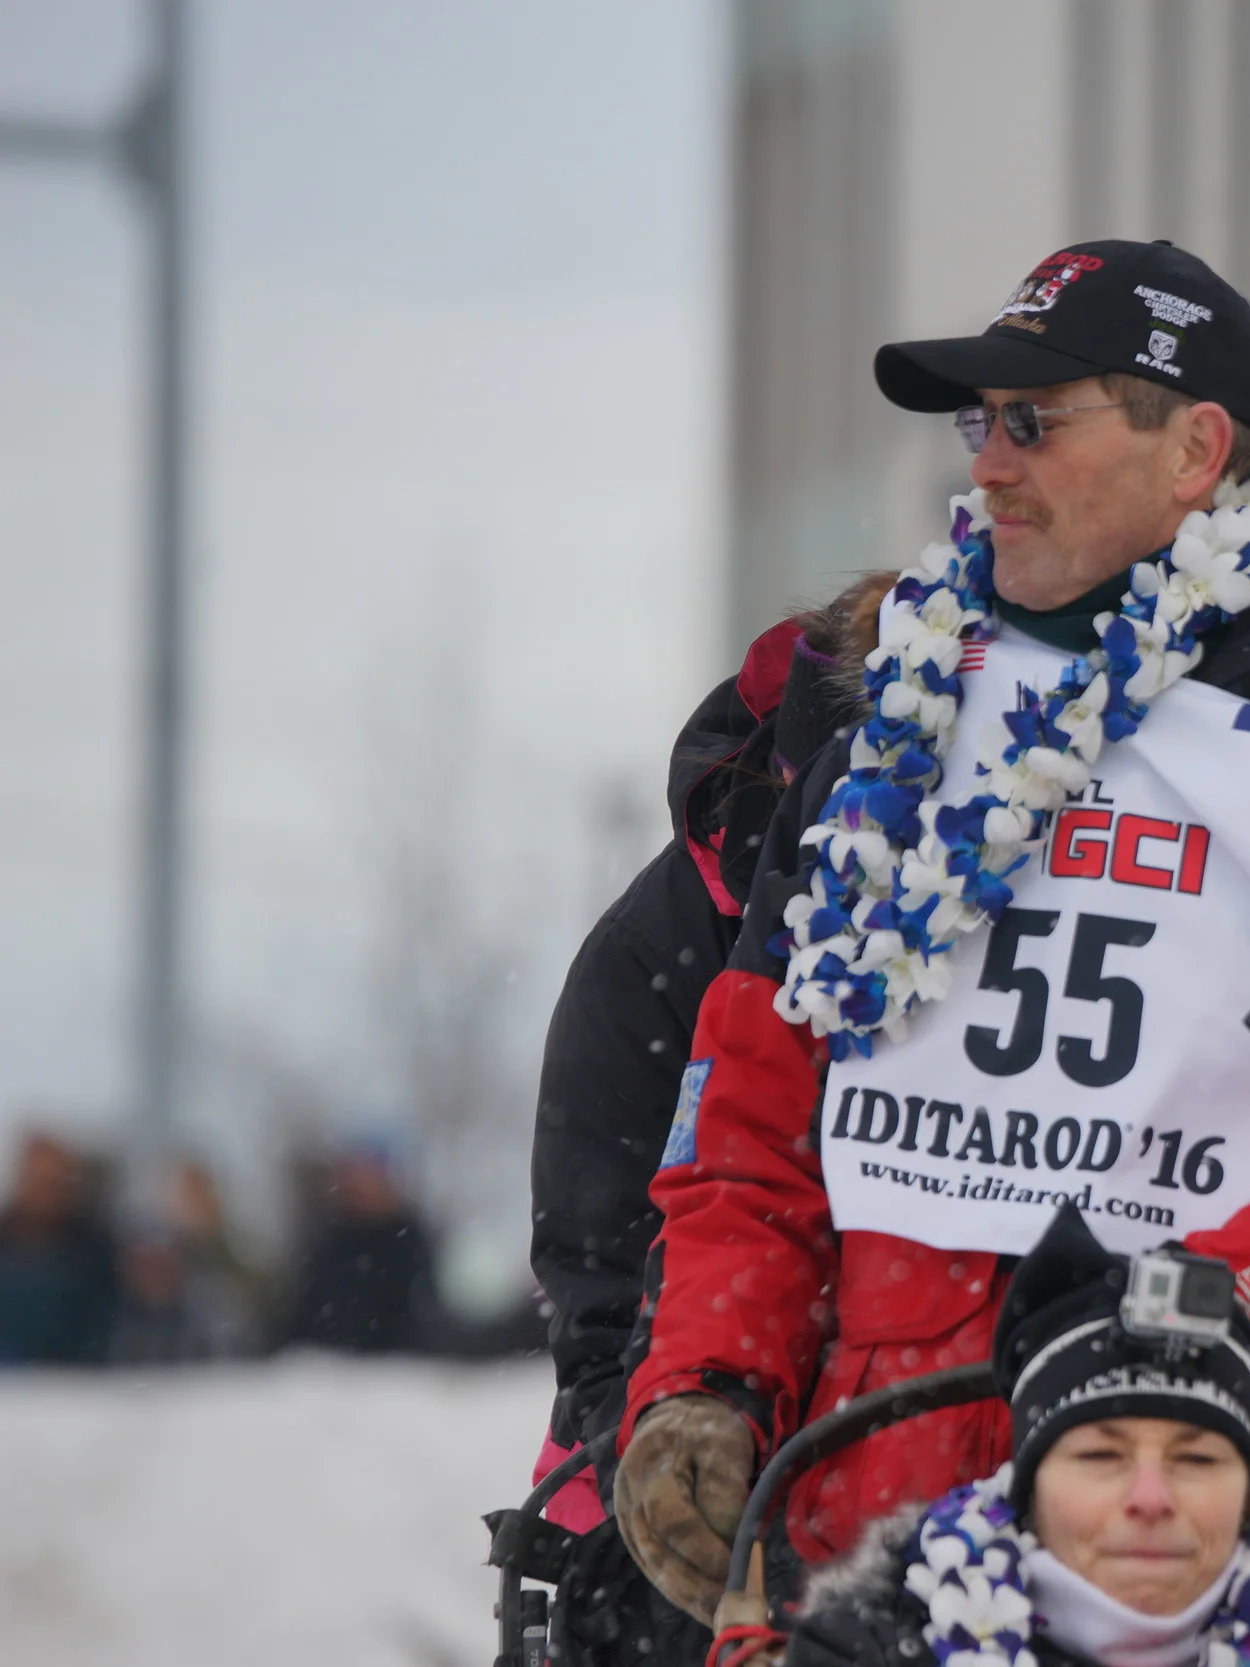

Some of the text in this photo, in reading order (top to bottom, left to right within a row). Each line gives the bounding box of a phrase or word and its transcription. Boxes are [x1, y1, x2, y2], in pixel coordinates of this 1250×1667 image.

[1133, 284, 1213, 322] ANCHORAGE
[1144, 299, 1199, 324] CHRYSLER
[1151, 309, 1188, 328] DODGE
[1134, 352, 1183, 377] RAM
[1050, 807, 1211, 895] GCI
[963, 907, 1157, 1087] 55
[830, 1086, 1226, 1194] IDITAROD '16
[860, 1160, 1175, 1226] www.iditarod.com
